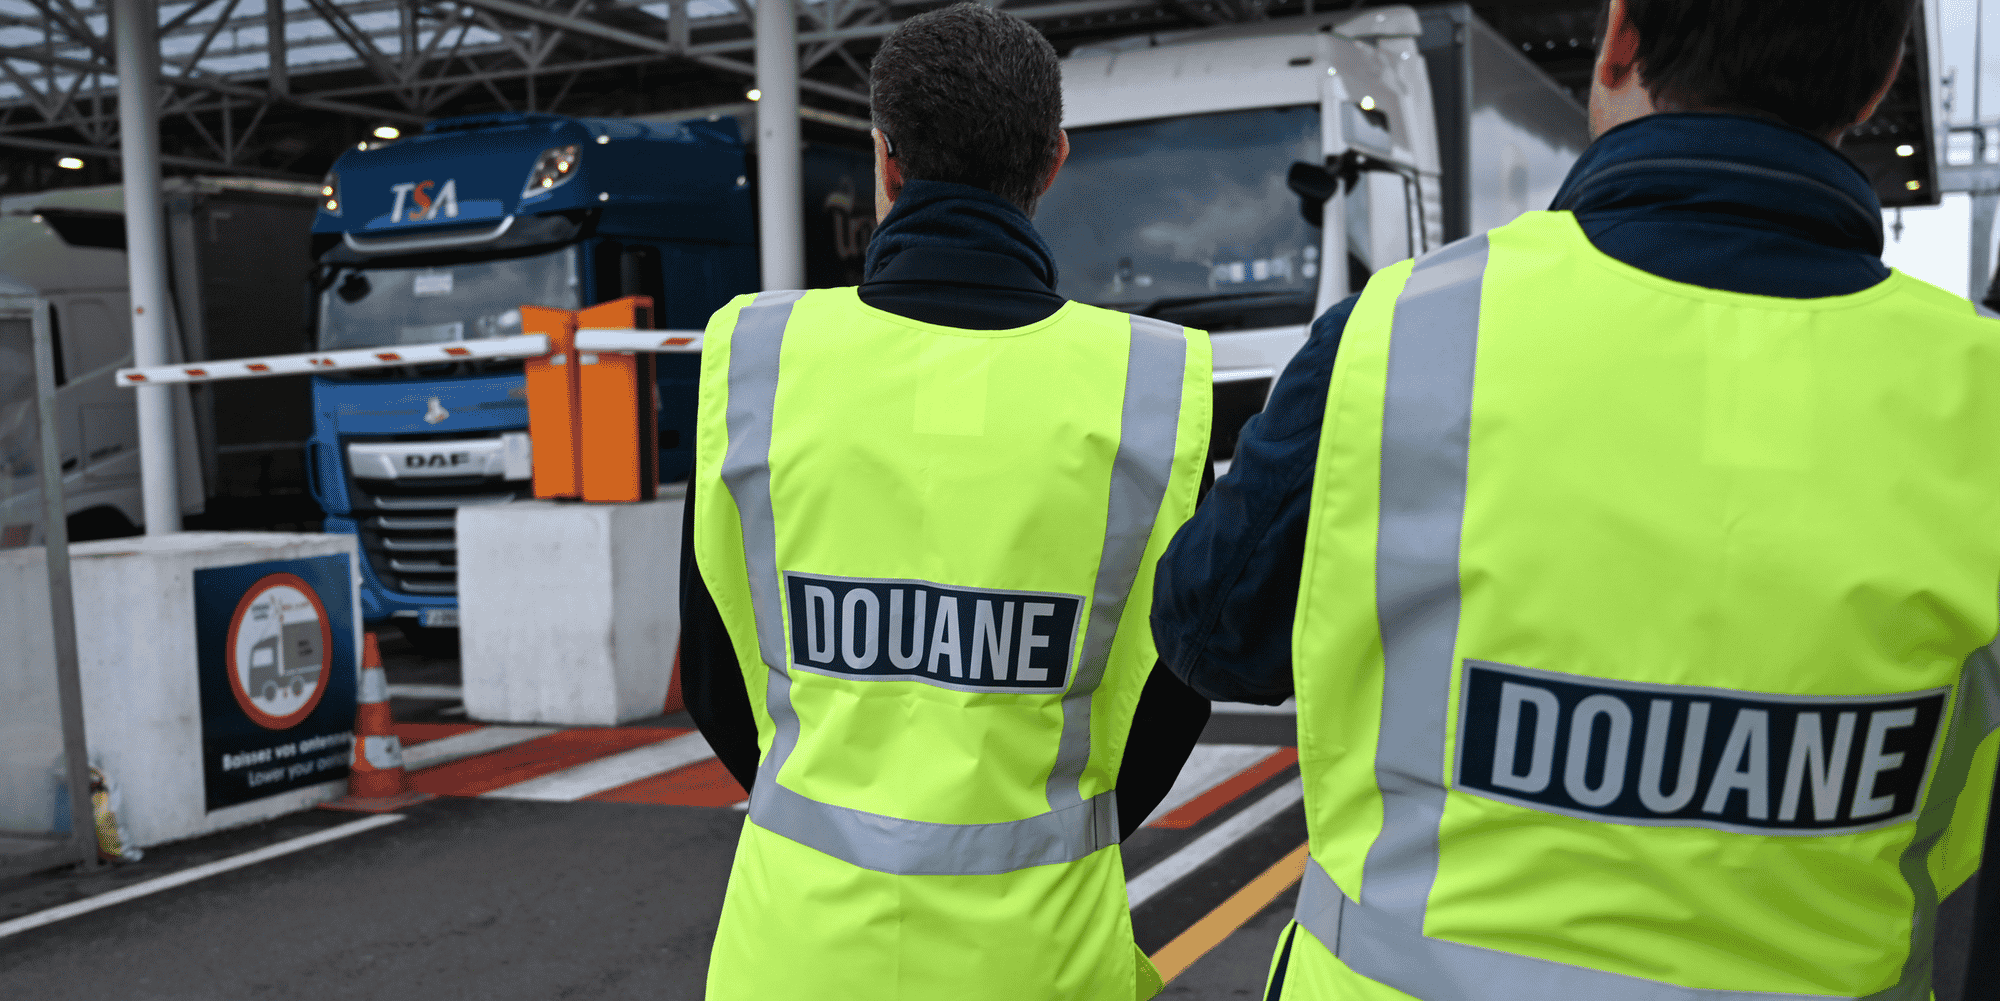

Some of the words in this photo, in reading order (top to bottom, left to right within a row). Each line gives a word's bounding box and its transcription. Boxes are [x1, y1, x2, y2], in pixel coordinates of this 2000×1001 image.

[390, 178, 459, 223] TSA
[405, 452, 470, 468] DAF
[804, 584, 1055, 682] DOUANE
[274, 743, 296, 758] vos
[1491, 681, 1918, 822] DOUANE
[248, 769, 285, 787] Lower
[288, 760, 314, 780] your
